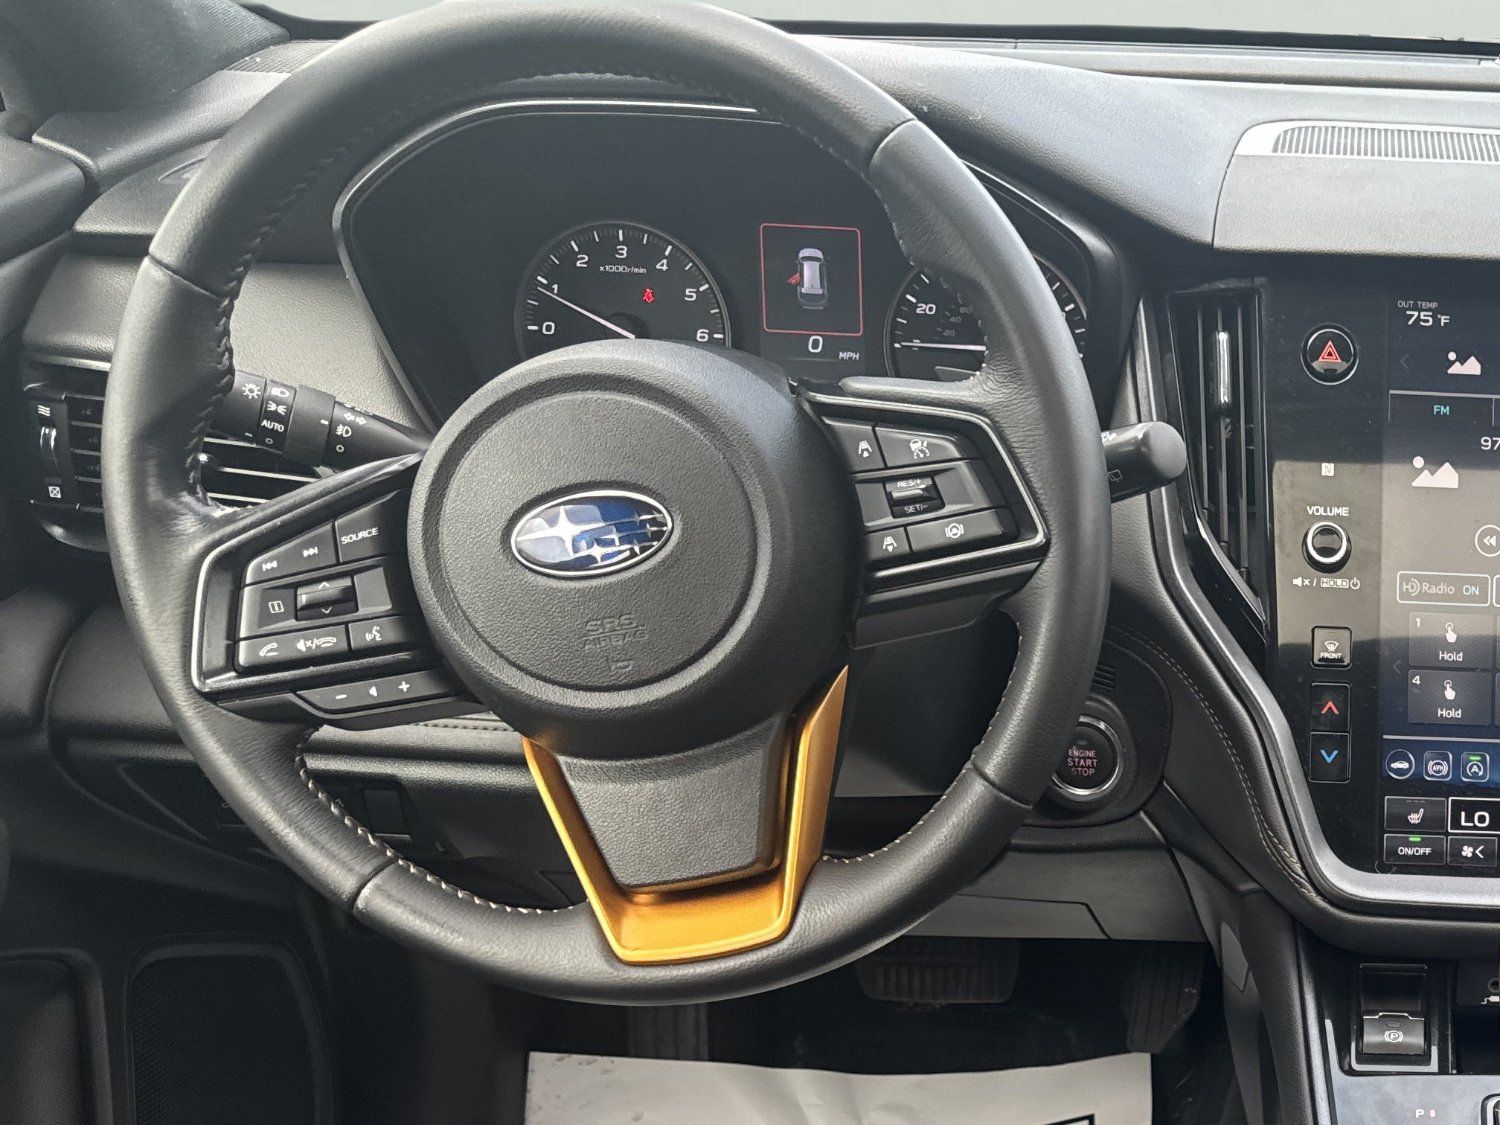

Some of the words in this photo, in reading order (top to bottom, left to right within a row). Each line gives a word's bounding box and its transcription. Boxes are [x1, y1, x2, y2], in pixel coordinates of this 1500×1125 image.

[615, 246, 628, 258] 3
[576, 255, 589, 267] 2
[656, 259, 669, 271] 4
[551, 283, 559, 294] 1
[685, 288, 697, 301] 5
[916, 303, 936, 315] 20
[1398, 300, 1414, 308] OUT
[1417, 301, 1438, 309] TEMP
[1406, 311, 1433, 326] 75
[542, 322, 555, 335] 0
[696, 329, 709, 342] 6
[808, 335, 823, 353] 0
[839, 351, 860, 361] MPH
[1434, 405, 1450, 415] FM
[261, 418, 285, 433] AUTO
[1307, 506, 1349, 517] VOLUME
[341, 527, 379, 545] SOURCE
[1422, 582, 1455, 594] Radio
[1463, 585, 1479, 595] ON
[1415, 617, 1421, 628] 1
[1320, 652, 1342, 660] FRONT
[1439, 651, 1463, 662] Hold
[1412, 675, 1421, 685] 4
[1437, 708, 1461, 719] Hold
[1068, 749, 1096, 758] ENGINE
[1067, 758, 1098, 767] START
[1071, 767, 1096, 776] STOP
[1460, 811, 1490, 828] LO
[1397, 847, 1432, 856] ON/OFF
[1415, 1109, 1425, 1119] P
